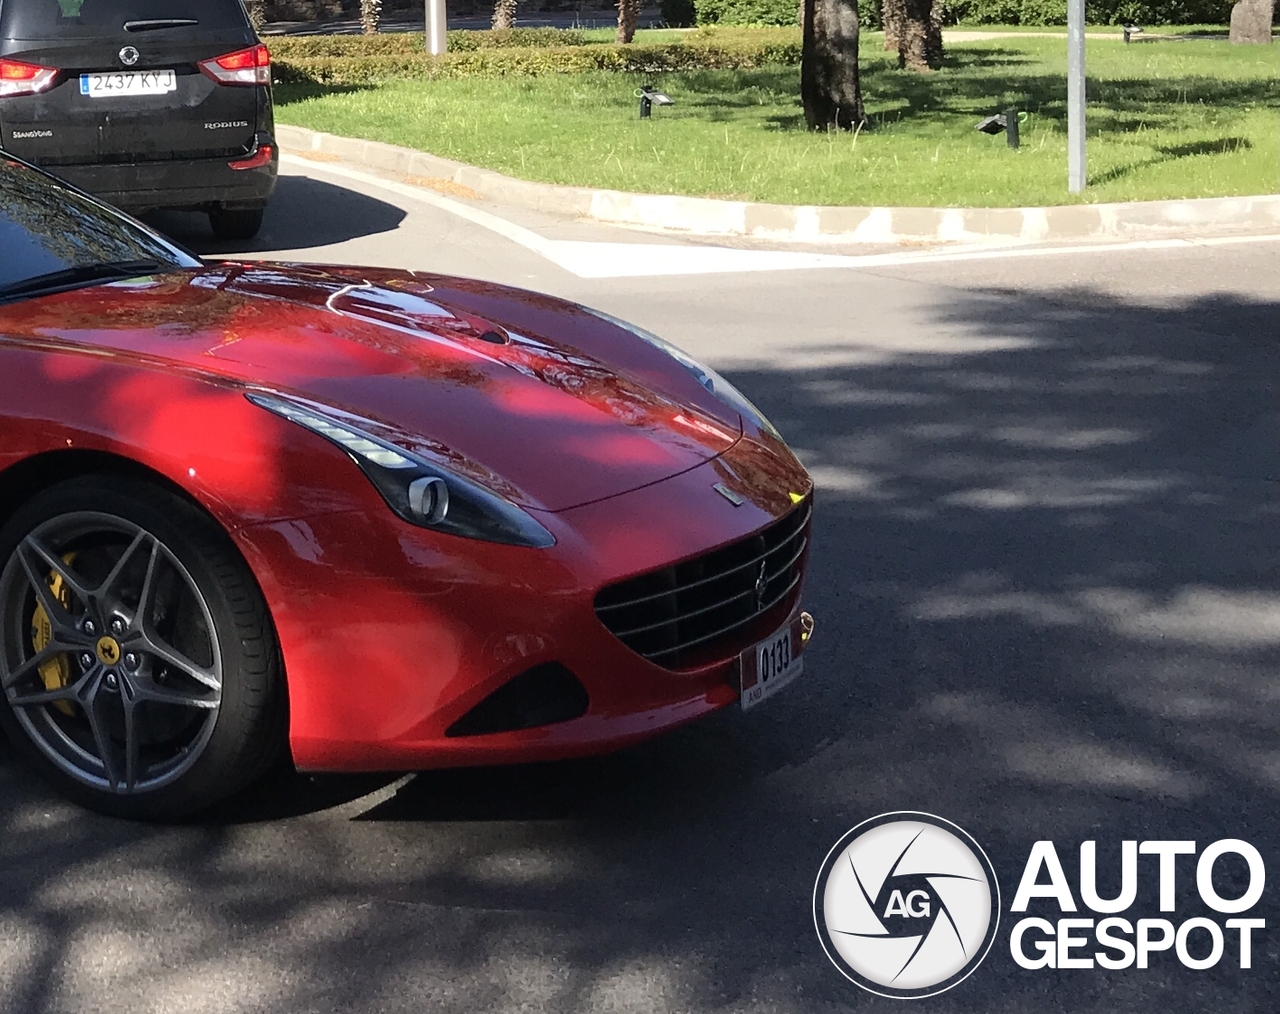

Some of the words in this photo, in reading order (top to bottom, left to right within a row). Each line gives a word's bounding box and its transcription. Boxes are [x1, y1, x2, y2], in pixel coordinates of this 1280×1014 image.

[93, 73, 136, 91] 2437
[140, 70, 173, 88] KYJ
[204, 120, 248, 130] RODIUS
[761, 634, 790, 683] 0133
